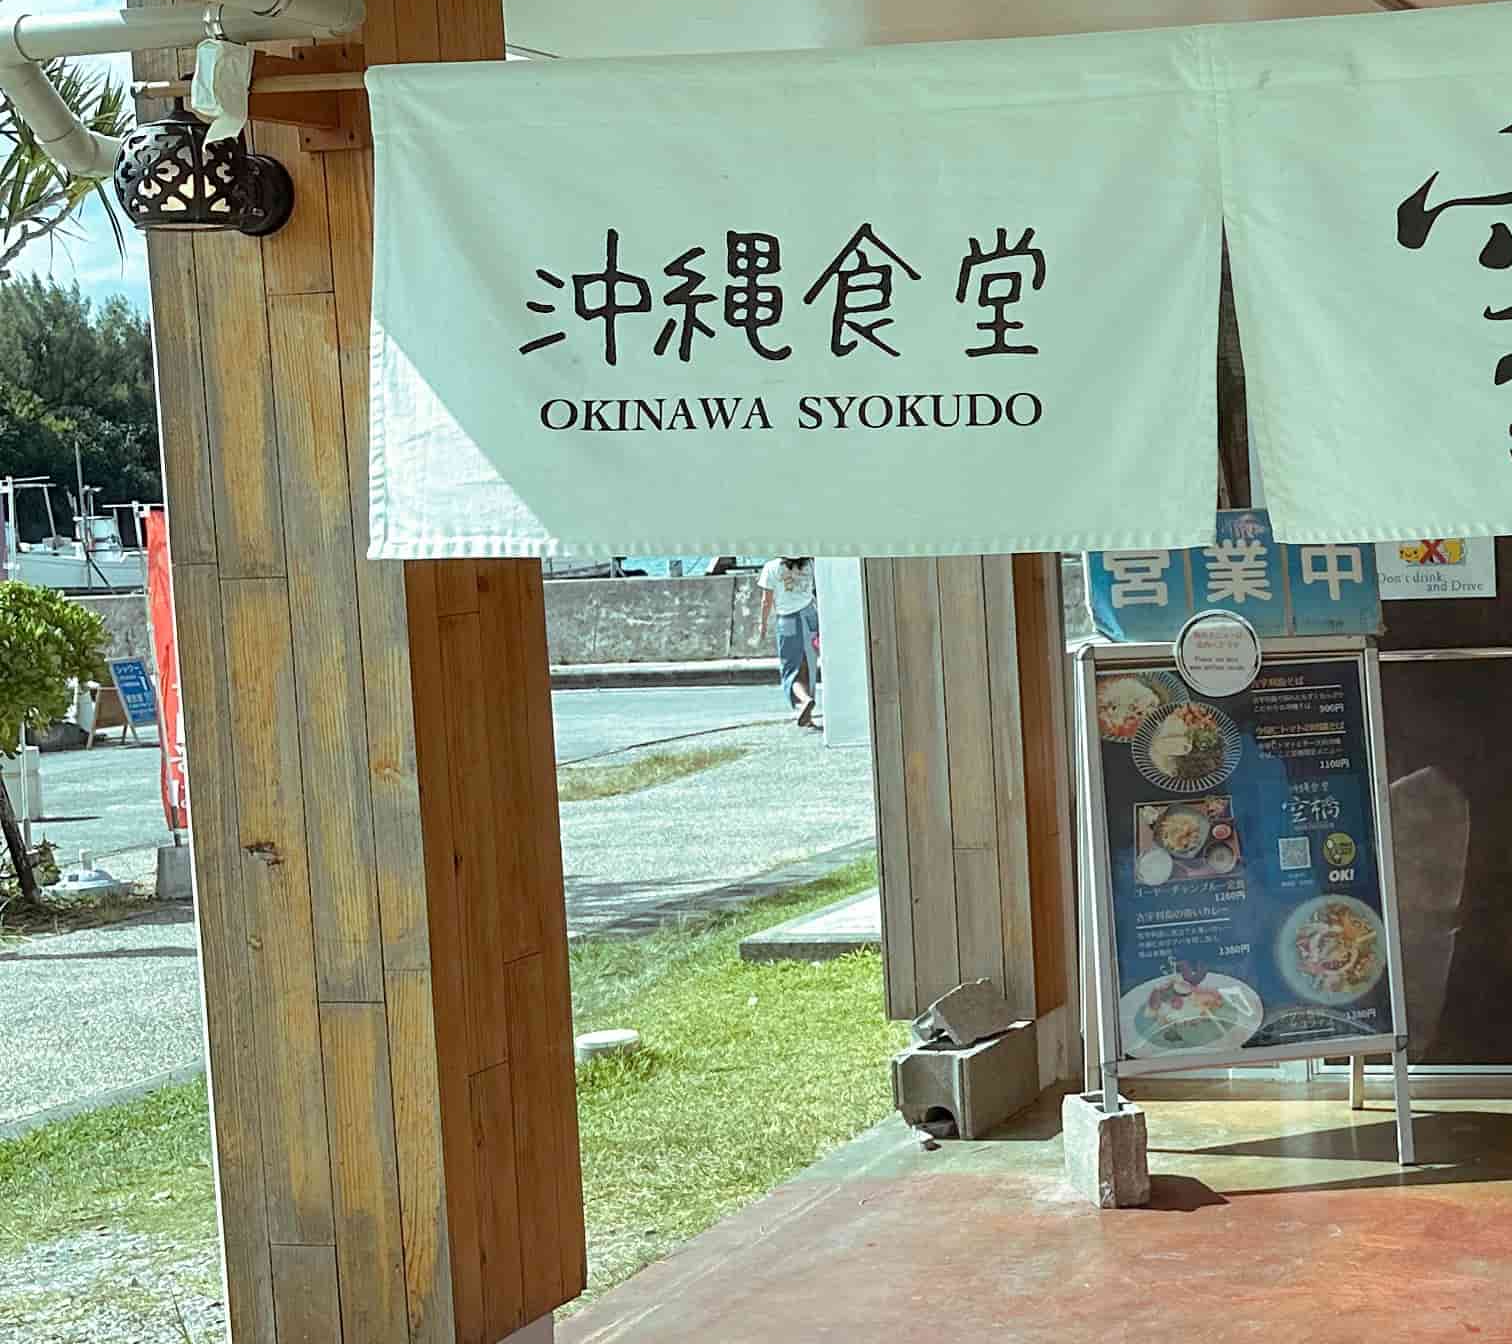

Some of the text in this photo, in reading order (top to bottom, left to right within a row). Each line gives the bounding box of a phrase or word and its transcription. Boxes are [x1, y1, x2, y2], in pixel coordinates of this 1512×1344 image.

[519, 223, 1046, 365] 沖縄食堂
[540, 392, 1042, 432] OKINAWA SYOKUDO
[1427, 578, 1484, 592] and Drive
